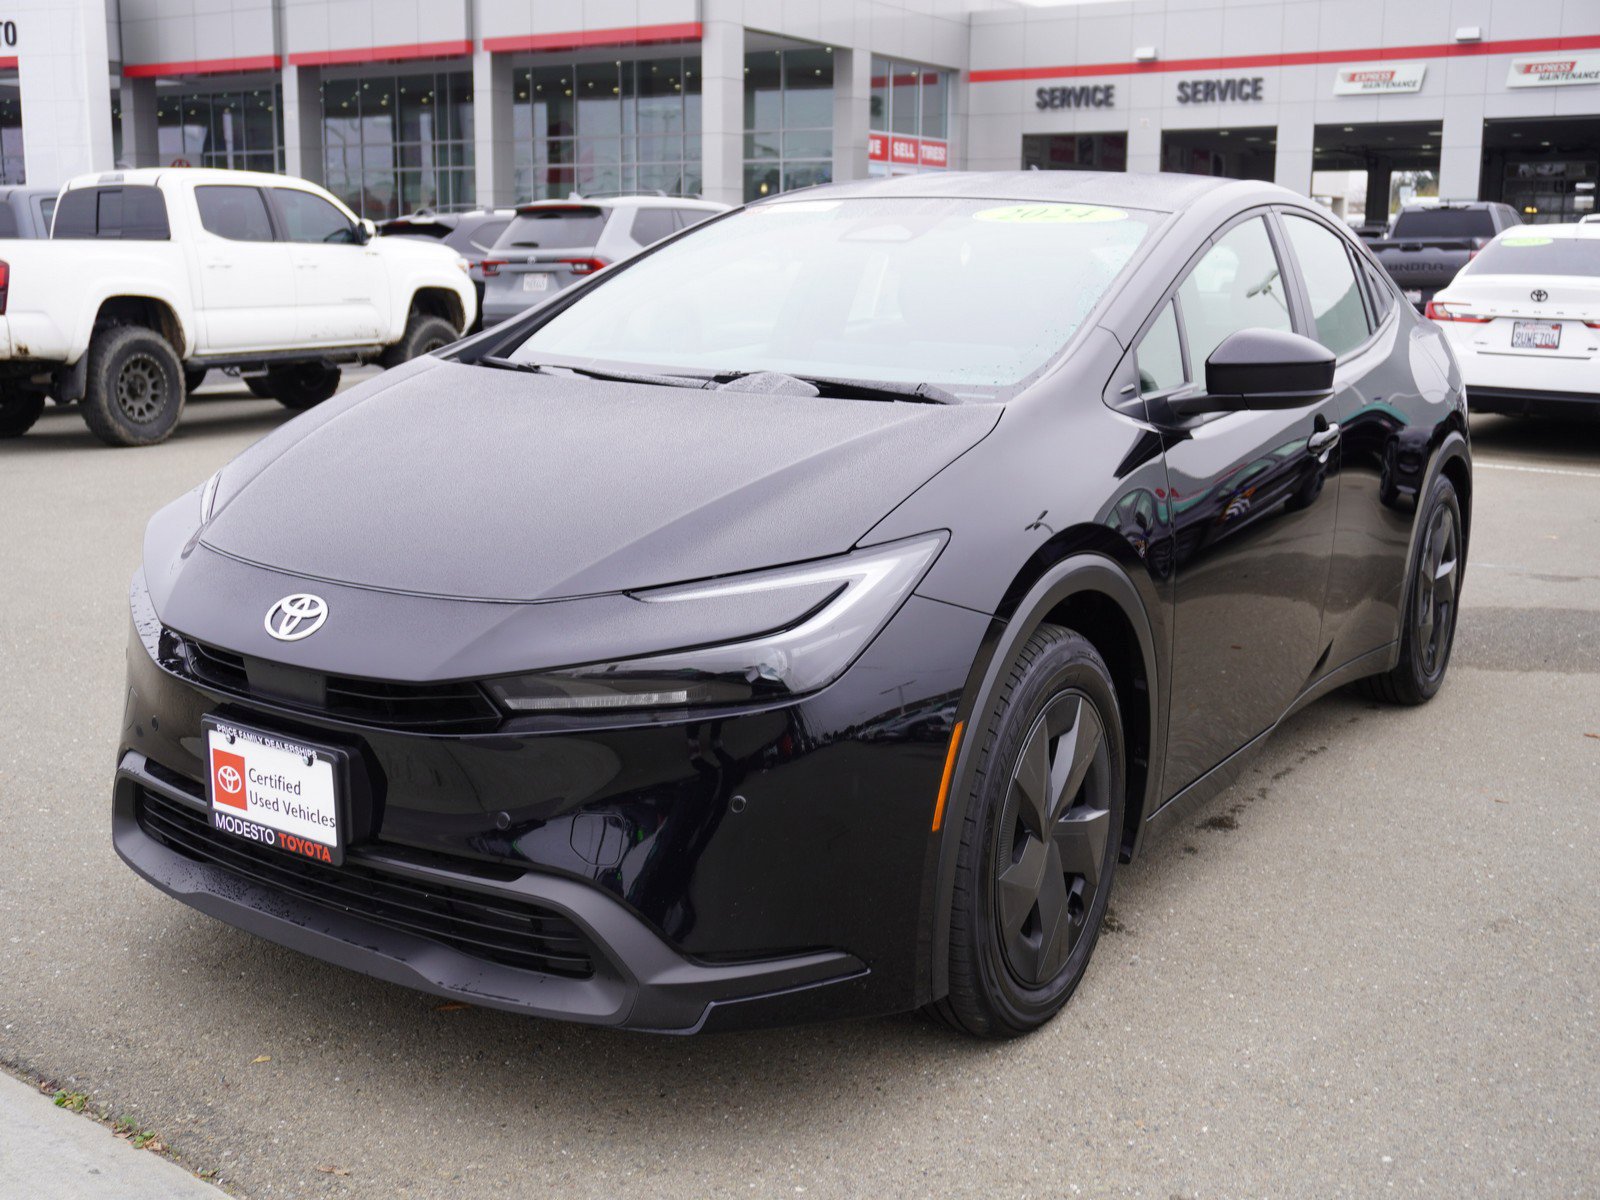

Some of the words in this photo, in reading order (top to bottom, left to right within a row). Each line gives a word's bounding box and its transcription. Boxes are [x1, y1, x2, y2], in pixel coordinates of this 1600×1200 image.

[1354, 71, 1391, 82] EXPRESS
[1530, 62, 1570, 73] EXPRESS
[1538, 71, 1600, 81] MAINTENANCE
[1176, 78, 1264, 104] SERVICE
[1362, 80, 1417, 89] MAINTENANCE
[1036, 84, 1115, 110] SERVICE
[893, 141, 915, 158] SELL
[1385, 262, 1444, 271] UNDRA
[216, 724, 239, 738] PRICE
[239, 730, 263, 745] FAMILY
[265, 738, 318, 760] DEALERSHIPS
[248, 768, 302, 796] Certified
[249, 790, 280, 812] Used
[282, 799, 336, 828] Vehicles
[215, 812, 276, 846] MODESTO
[278, 832, 332, 863] TOYOTA
